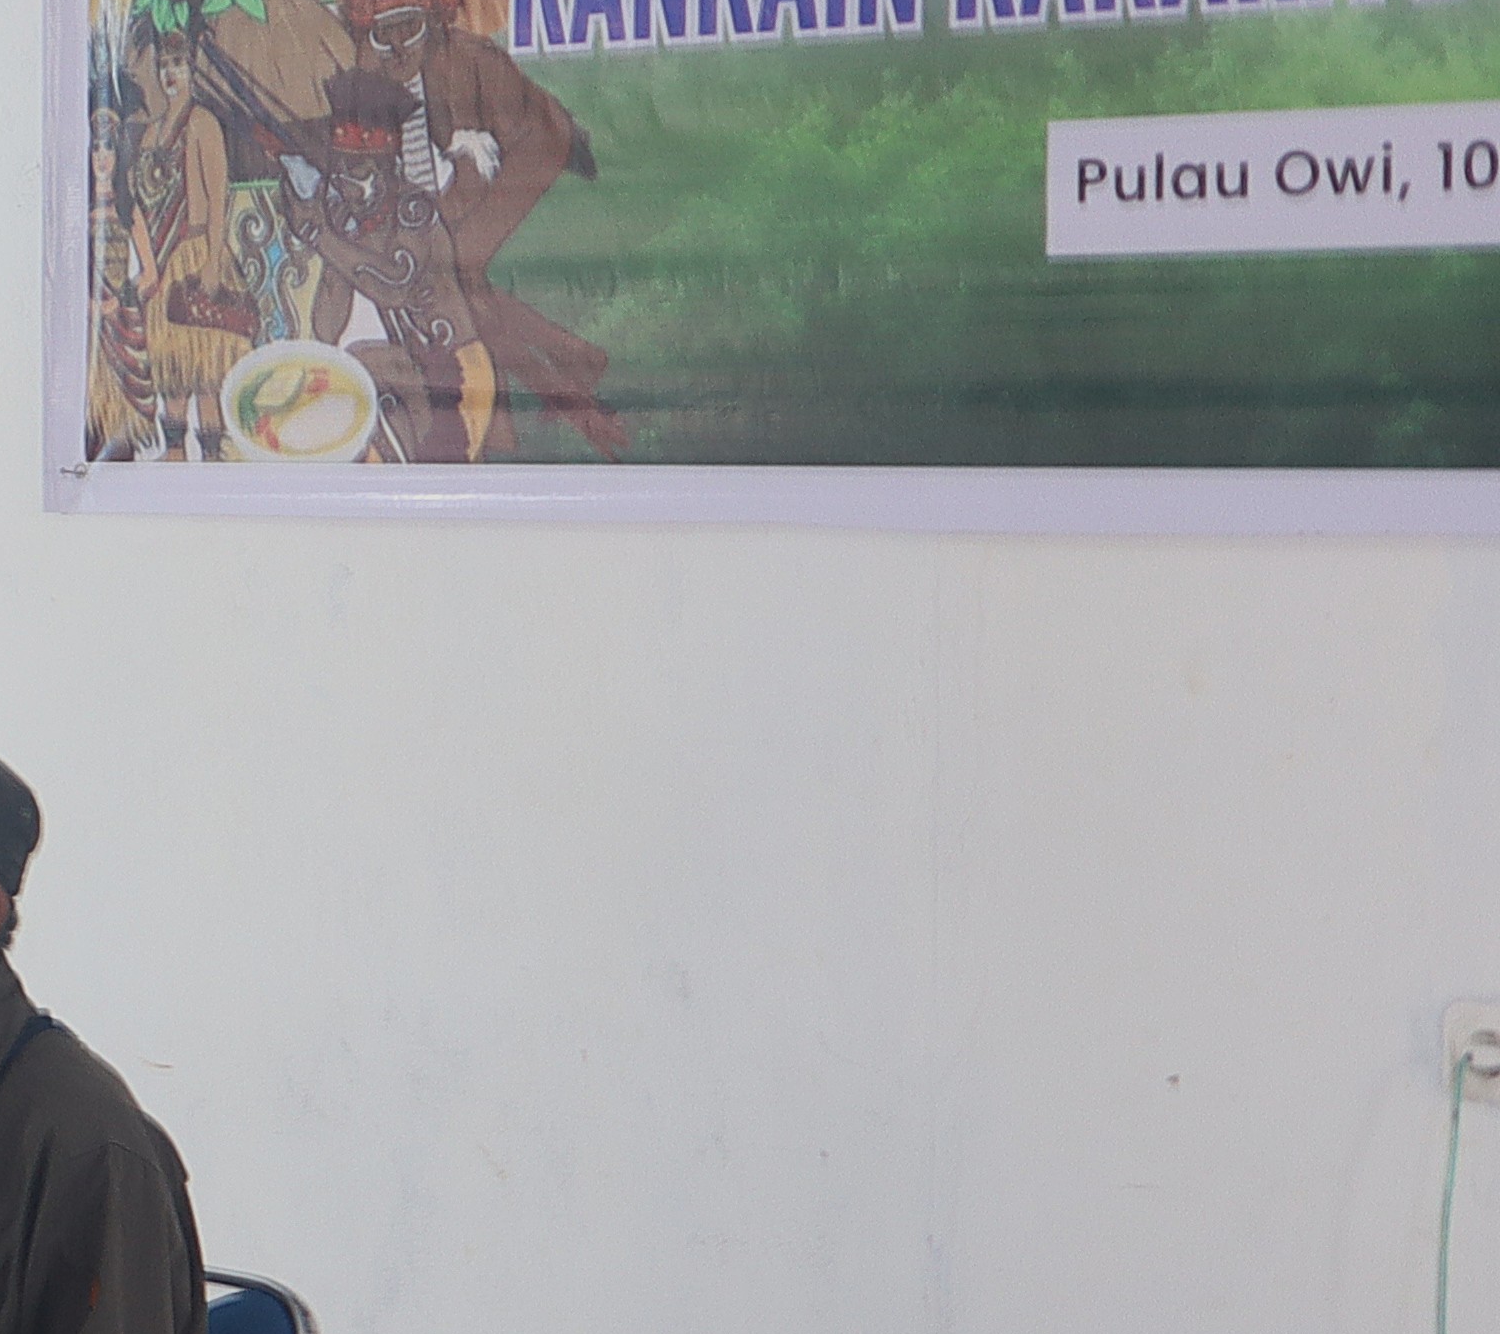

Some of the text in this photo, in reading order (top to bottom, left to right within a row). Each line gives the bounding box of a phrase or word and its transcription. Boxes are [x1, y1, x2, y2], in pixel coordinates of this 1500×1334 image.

[1077, 139, 1500, 204] Pulau Owi, 10
